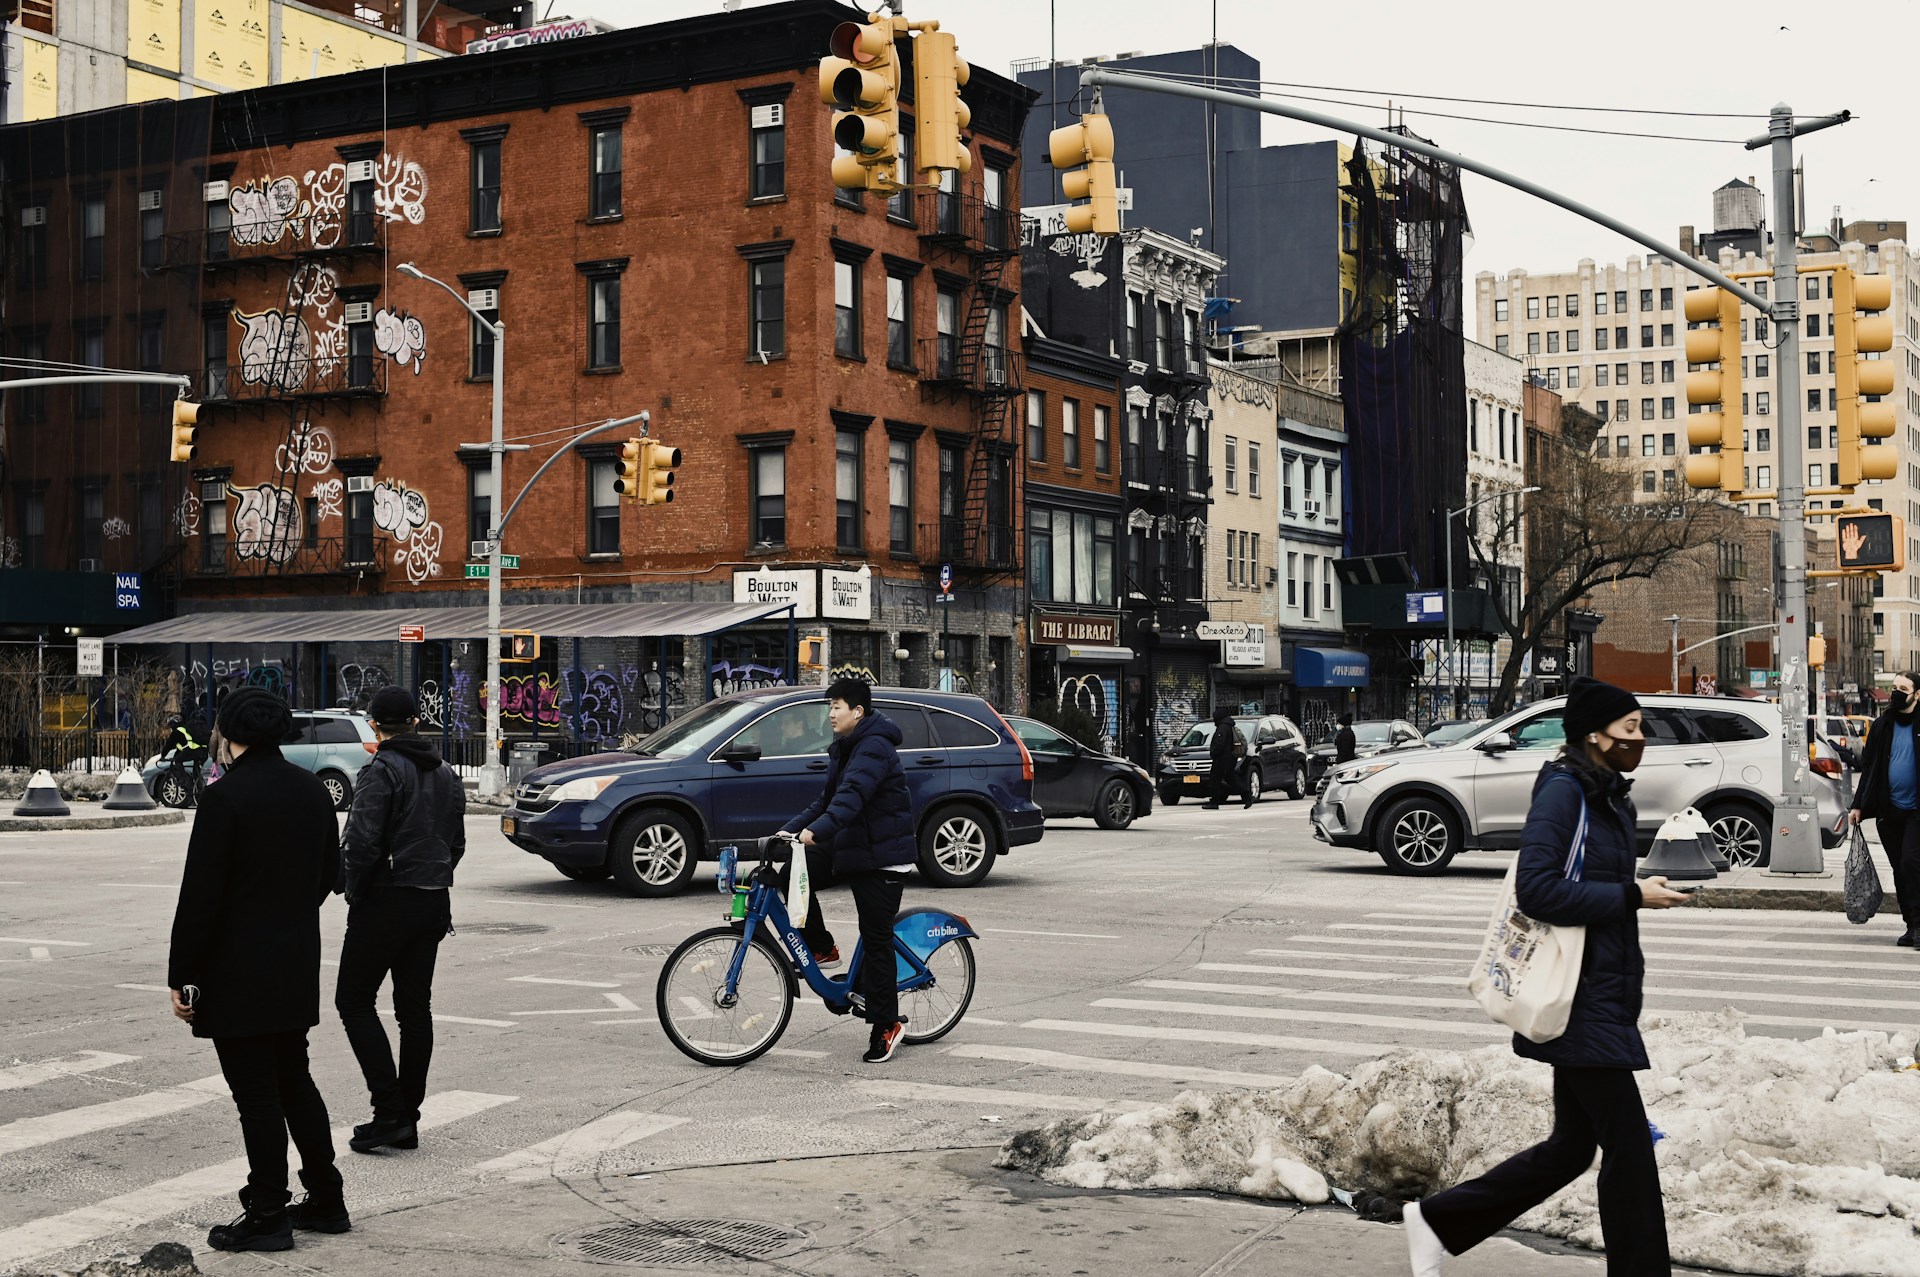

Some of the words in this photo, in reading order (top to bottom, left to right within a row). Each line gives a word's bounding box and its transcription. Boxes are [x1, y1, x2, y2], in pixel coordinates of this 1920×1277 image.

[501, 557, 512, 567] Ave
[513, 557, 517, 567] A
[470, 566, 474, 577] E
[116, 576, 140, 590] NAIL
[748, 577, 798, 593] BOULTON
[832, 576, 862, 593] BOULTON
[118, 594, 139, 607] SPA
[1041, 621, 1063, 639] THE
[1067, 623, 1112, 641] LIBRARY
[1202, 625, 1244, 635] Drexler's
[83, 653, 97, 661] MUST
[927, 925, 941, 938] citi
[941, 925, 959, 937] bike
[786, 932, 800, 949] citi
[794, 944, 810, 968] bike
